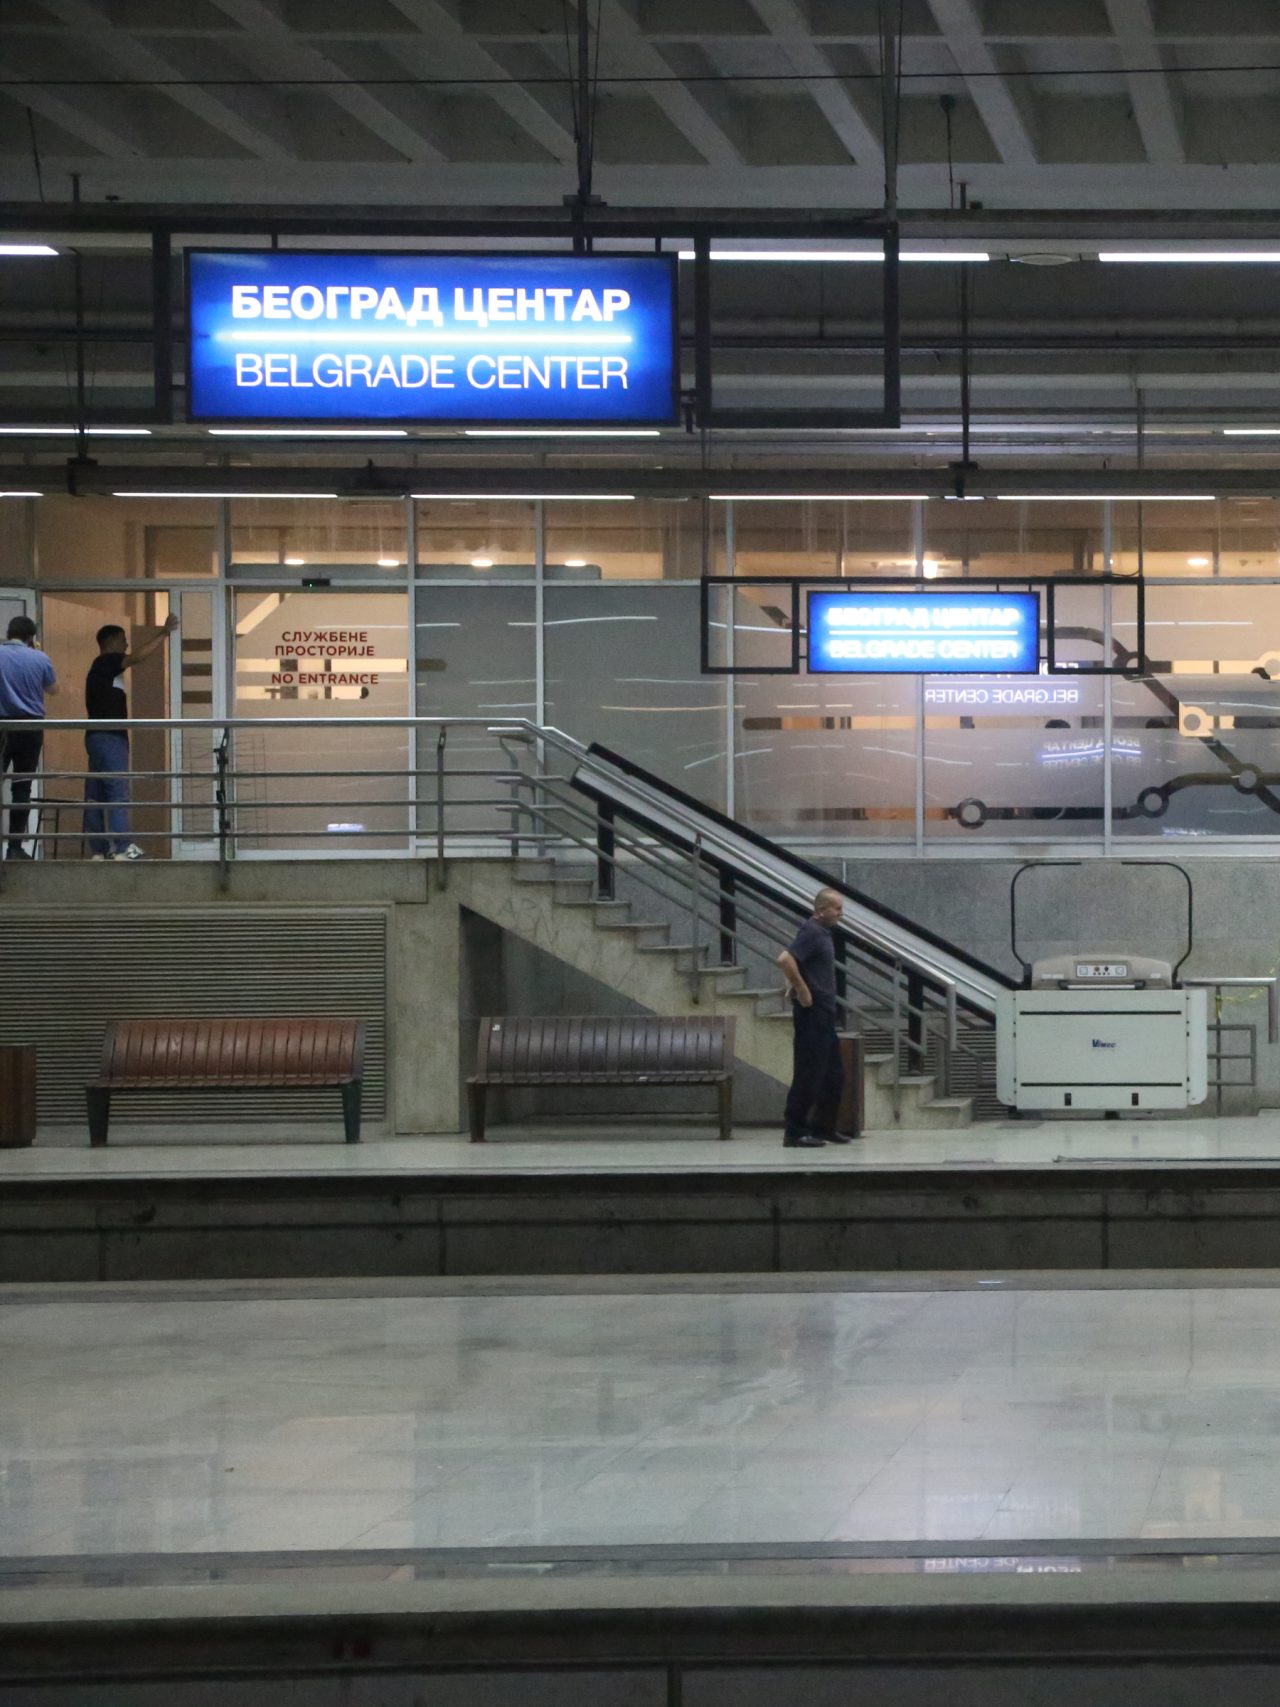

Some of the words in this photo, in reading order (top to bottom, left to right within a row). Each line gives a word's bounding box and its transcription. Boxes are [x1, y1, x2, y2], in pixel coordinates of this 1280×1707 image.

[231, 284, 444, 327] БЕОГРАД
[453, 287, 632, 328] ЦЕНТАР
[235, 353, 455, 389] BELGRADE
[466, 354, 629, 390] CENTER
[281, 631, 368, 643] СЛУЖБЕНЕ
[275, 645, 375, 657] ПРОСТОРИЈЕ
[829, 639, 936, 659] BELGRADE
[937, 639, 1019, 659] CENTER
[271, 673, 294, 685] NO
[298, 673, 379, 685] ENTRANCE
